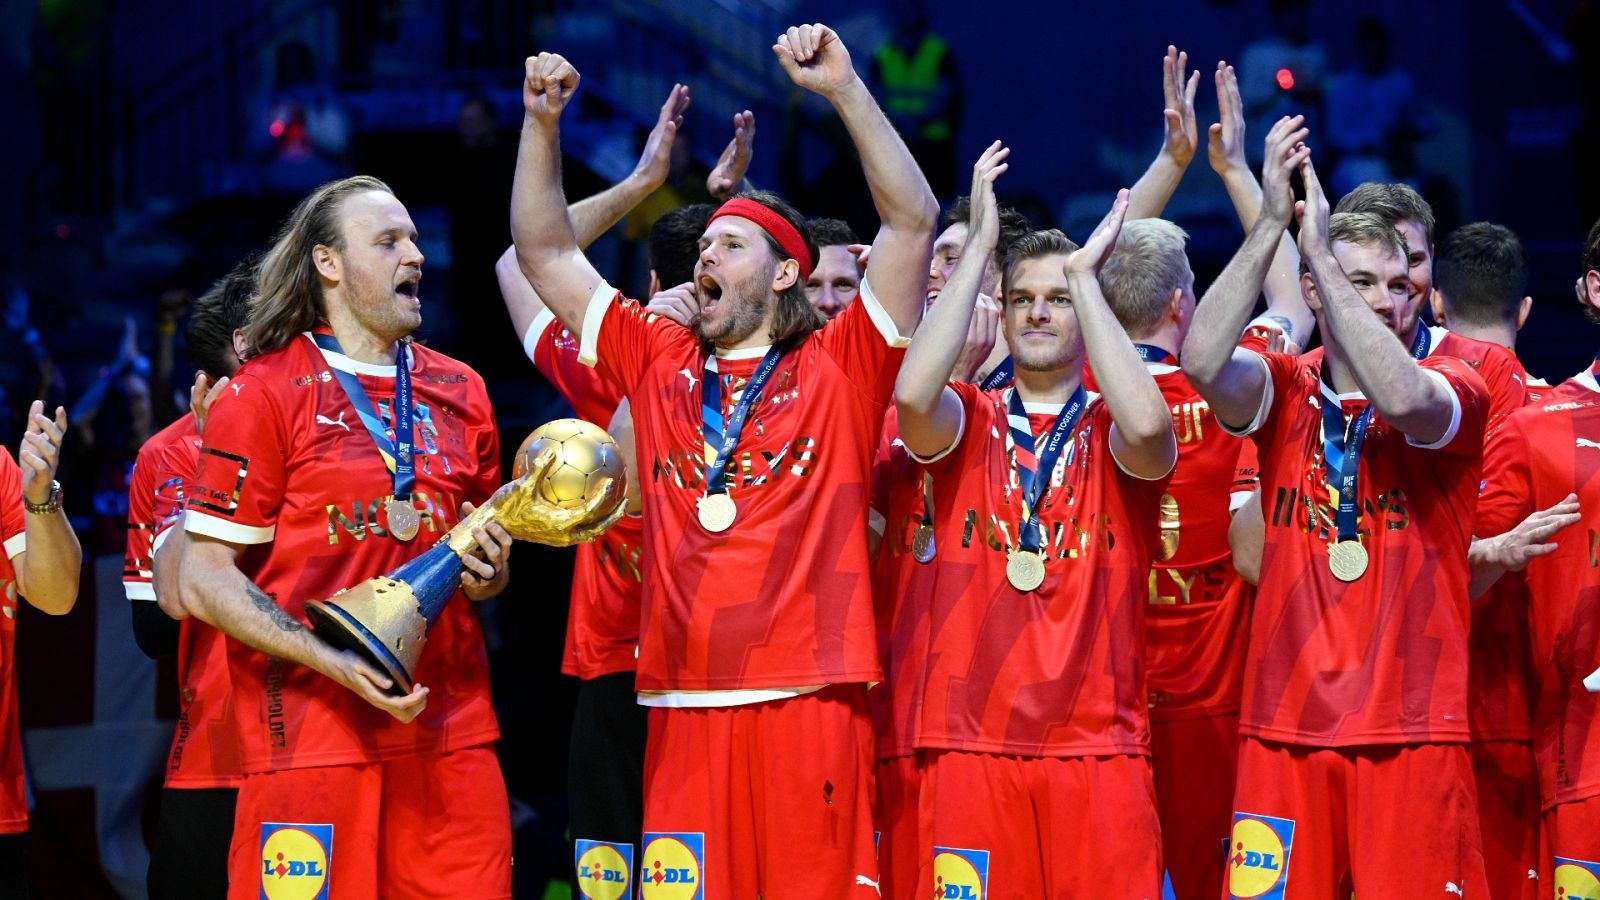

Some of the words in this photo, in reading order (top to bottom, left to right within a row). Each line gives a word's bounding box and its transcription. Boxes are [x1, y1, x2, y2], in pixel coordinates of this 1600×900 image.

[1048, 431, 1062, 452] STICK
[1058, 402, 1081, 432] TOGETHER.
[1172, 400, 1210, 443] UP
[1149, 564, 1227, 605] LYS
